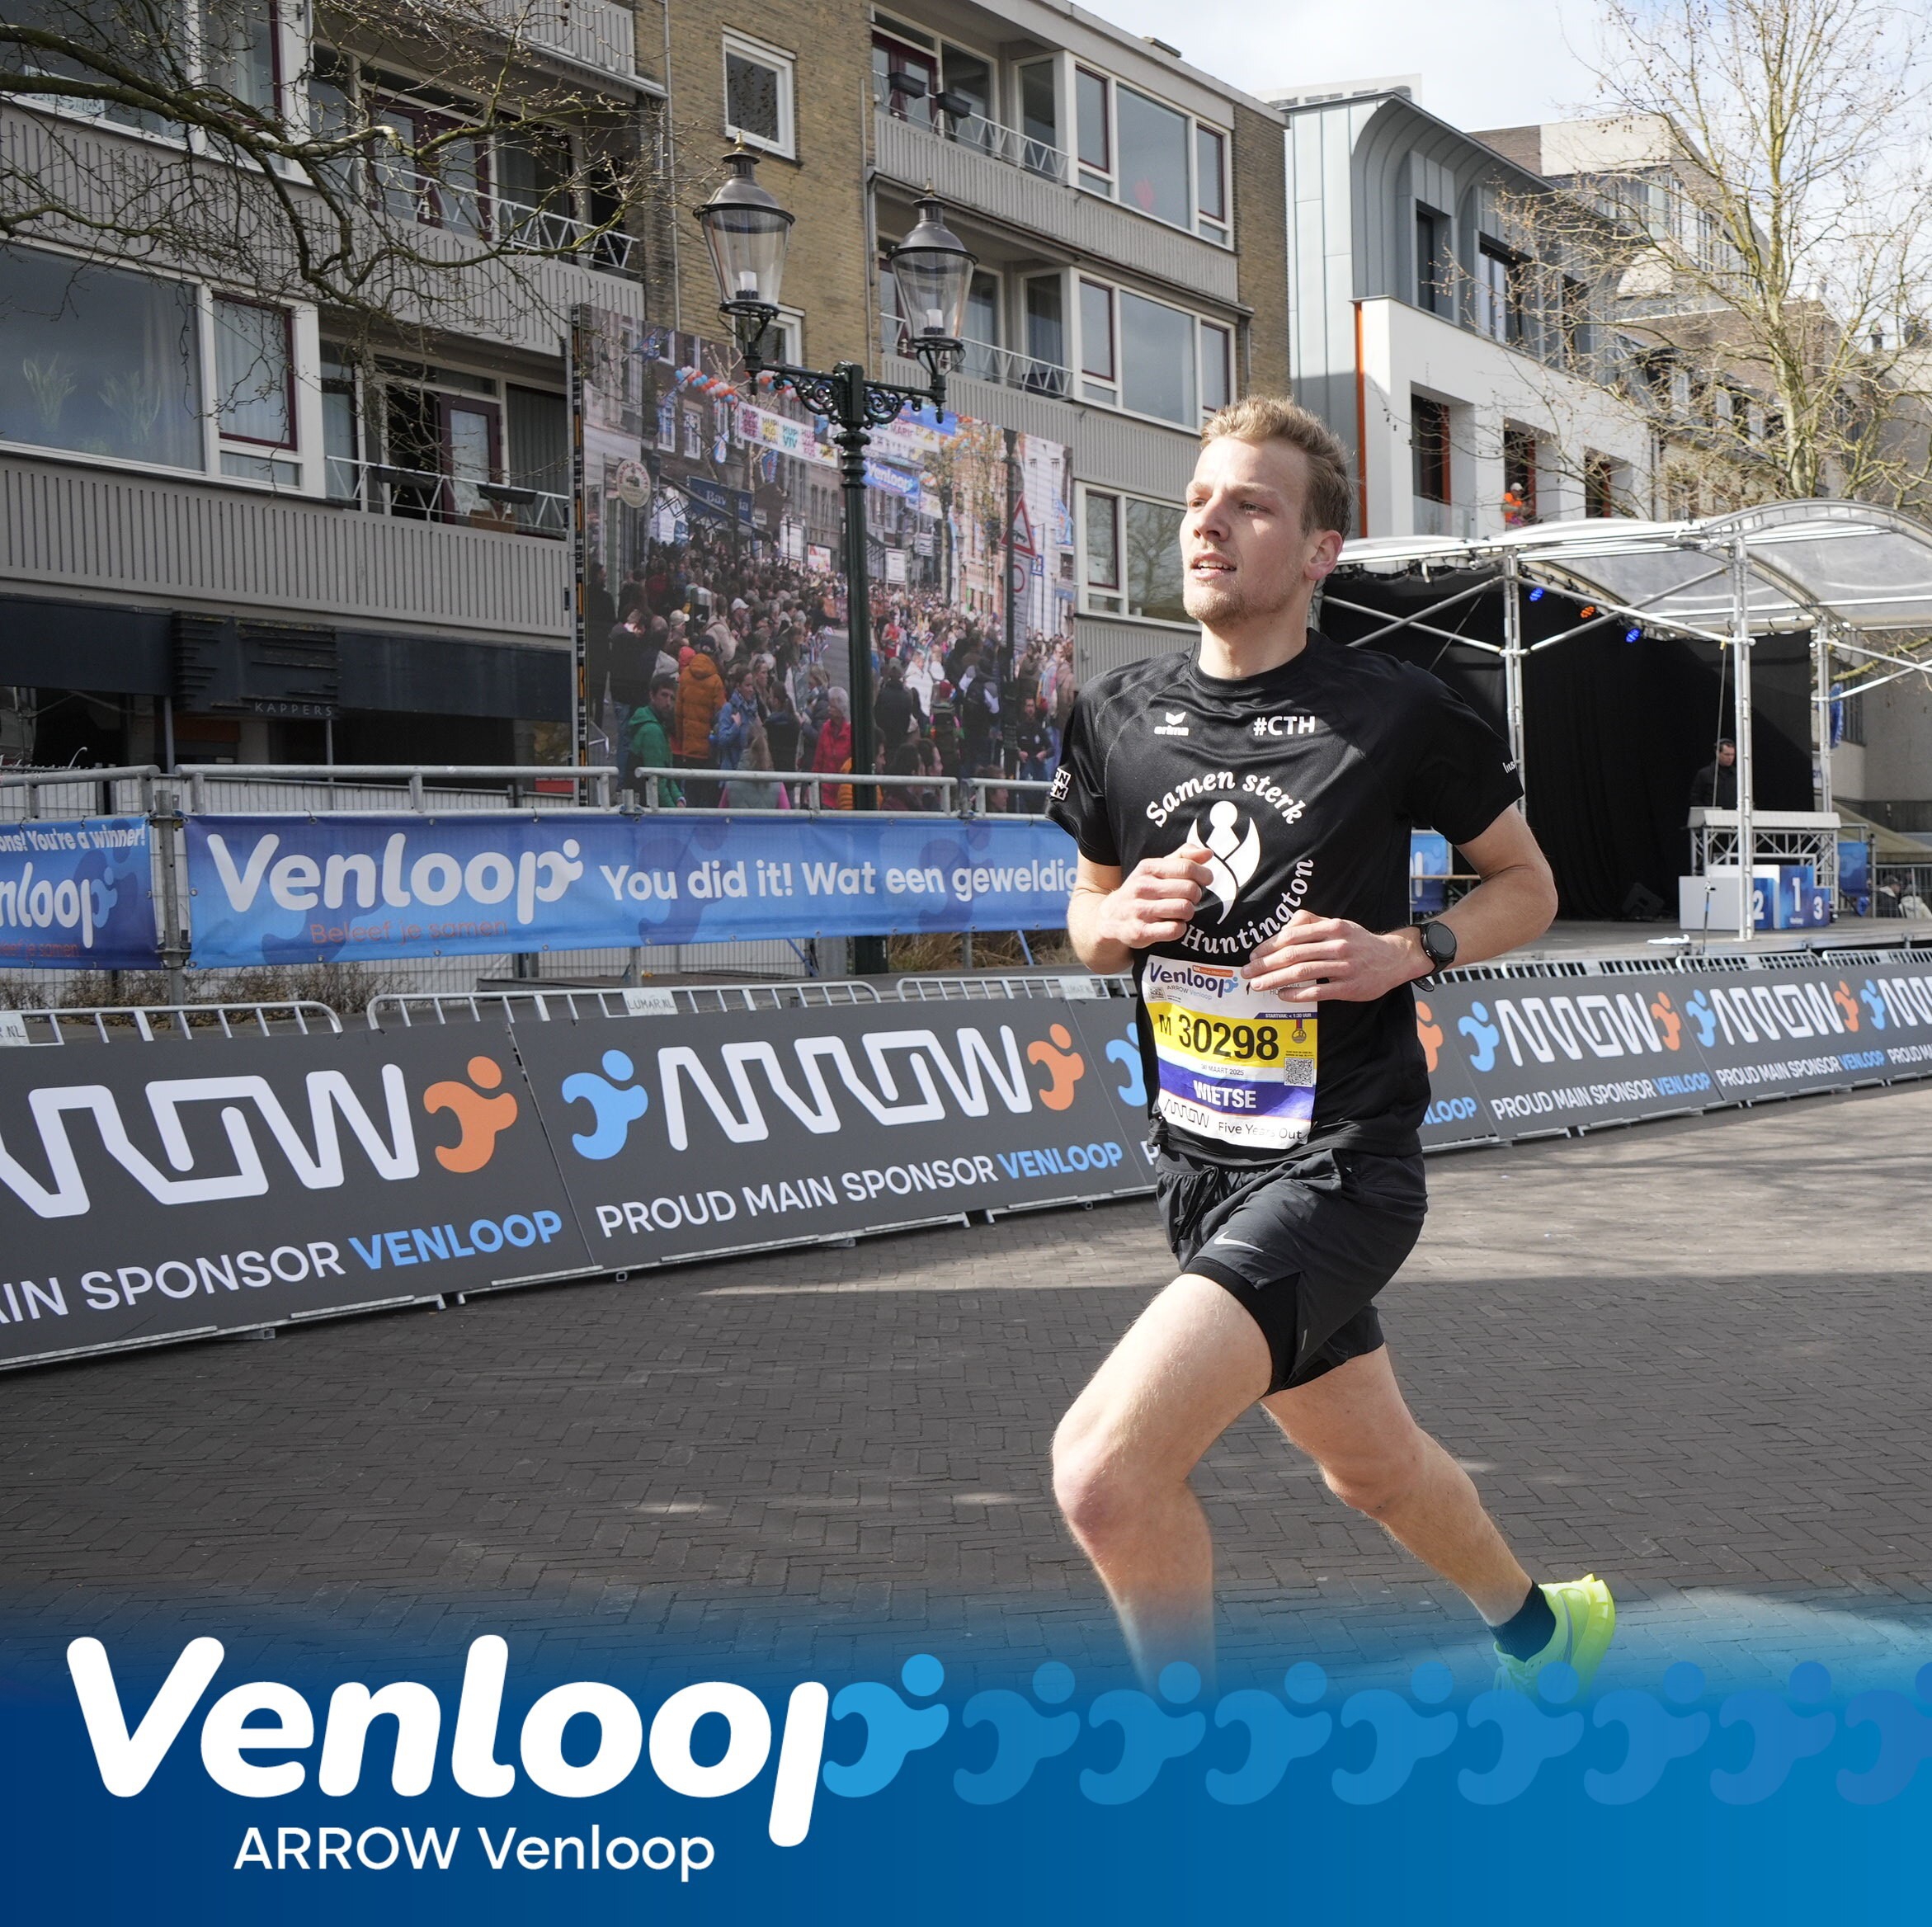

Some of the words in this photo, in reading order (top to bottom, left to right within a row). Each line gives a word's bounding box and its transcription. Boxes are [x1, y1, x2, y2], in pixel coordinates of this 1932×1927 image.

[706, 490, 749, 511] Bavia
[255, 702, 332, 716] KAPPERS
[1253, 716, 1315, 736] #CTH
[1146, 771, 1236, 827] Samen
[1242, 774, 1306, 824] sterk
[26, 828, 77, 850] You're
[78, 832, 90, 849] a
[89, 824, 146, 849] winner!
[206, 833, 583, 925] Venloop
[600, 865, 678, 901] You
[687, 860, 748, 898] did
[756, 859, 793, 898] it!
[801, 861, 876, 896] Wat
[885, 867, 946, 893] een
[1792, 877, 1801, 912] 1
[0, 861, 118, 949] nloop
[1181, 859, 1314, 954] Huntington
[1753, 890, 1765, 921] 2
[1813, 896, 1823, 921] 3
[310, 921, 392, 944] Beleef
[401, 920, 422, 945] je
[429, 921, 507, 939] samen
[1150, 962, 1238, 998] Venloop
[1158, 1014, 1171, 1035] M
[1178, 1014, 1279, 1060] 30298
[1208, 1064, 1228, 1074] MAART
[1715, 1066, 1760, 1087] PROUD
[1757, 1062, 1791, 1082] MAIN
[1787, 1055, 1843, 1077] SPONSOR
[1837, 1049, 1885, 1071] VENLOOP
[1887, 1045, 1923, 1065] PROUD
[657, 1025, 1032, 1152] ARROW
[1193, 1080, 1256, 1109] WIETSE
[1490, 1091, 1553, 1120] PROUD
[1552, 1086, 1594, 1110] MAIN
[1590, 1079, 1657, 1105] SPONSOR
[1652, 1072, 1712, 1095] VENLOOP
[1218, 1121, 1242, 1134] Five
[1279, 1128, 1303, 1140] Out
[596, 1190, 737, 1237] PROUD
[742, 1176, 838, 1217] MAIN
[841, 1155, 999, 1202] SPONSOR
[997, 1142, 1123, 1180] VENLOOP
[81, 1240, 346, 1310] SPONSOR
[347, 1209, 563, 1271] VENLOOP
